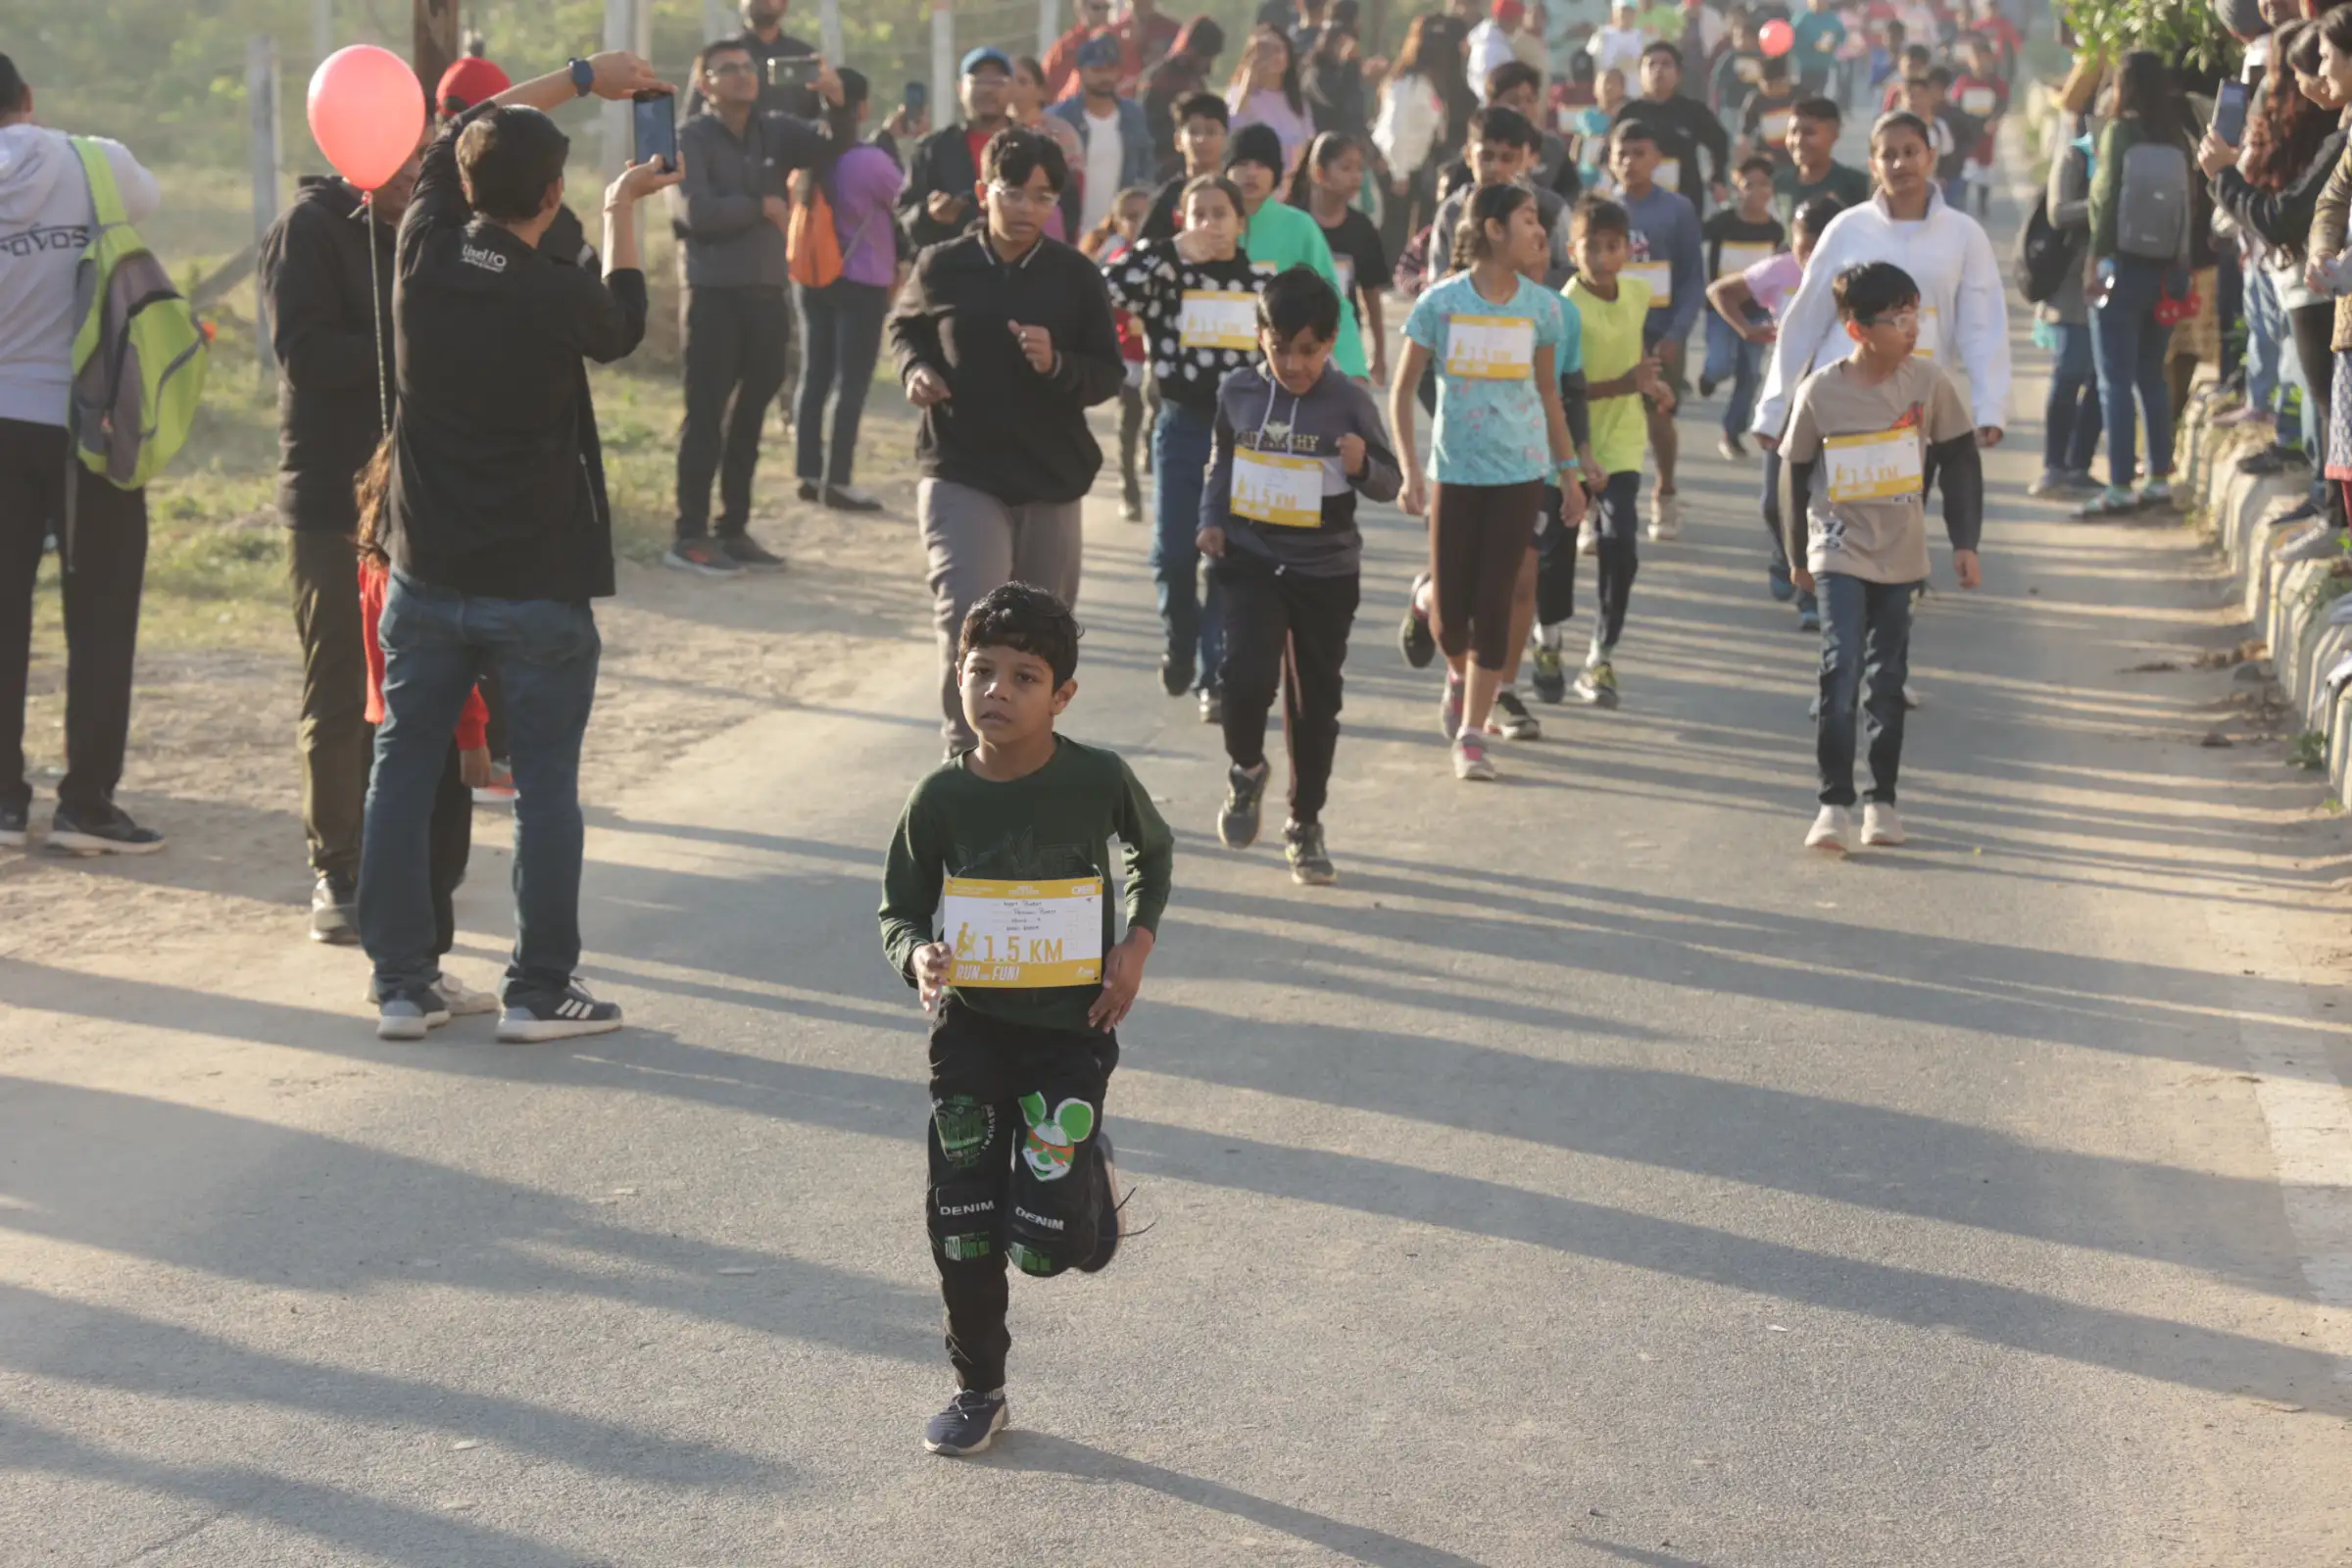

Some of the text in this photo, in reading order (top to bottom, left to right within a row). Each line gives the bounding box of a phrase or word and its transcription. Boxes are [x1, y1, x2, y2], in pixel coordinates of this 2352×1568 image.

[983, 934, 1063, 963] 1.5 KM
[956, 964, 980, 980] RUN
[992, 965, 1019, 980] FUN!
[940, 1200, 995, 1216] DENIM
[1015, 1205, 1064, 1231] DENIM
